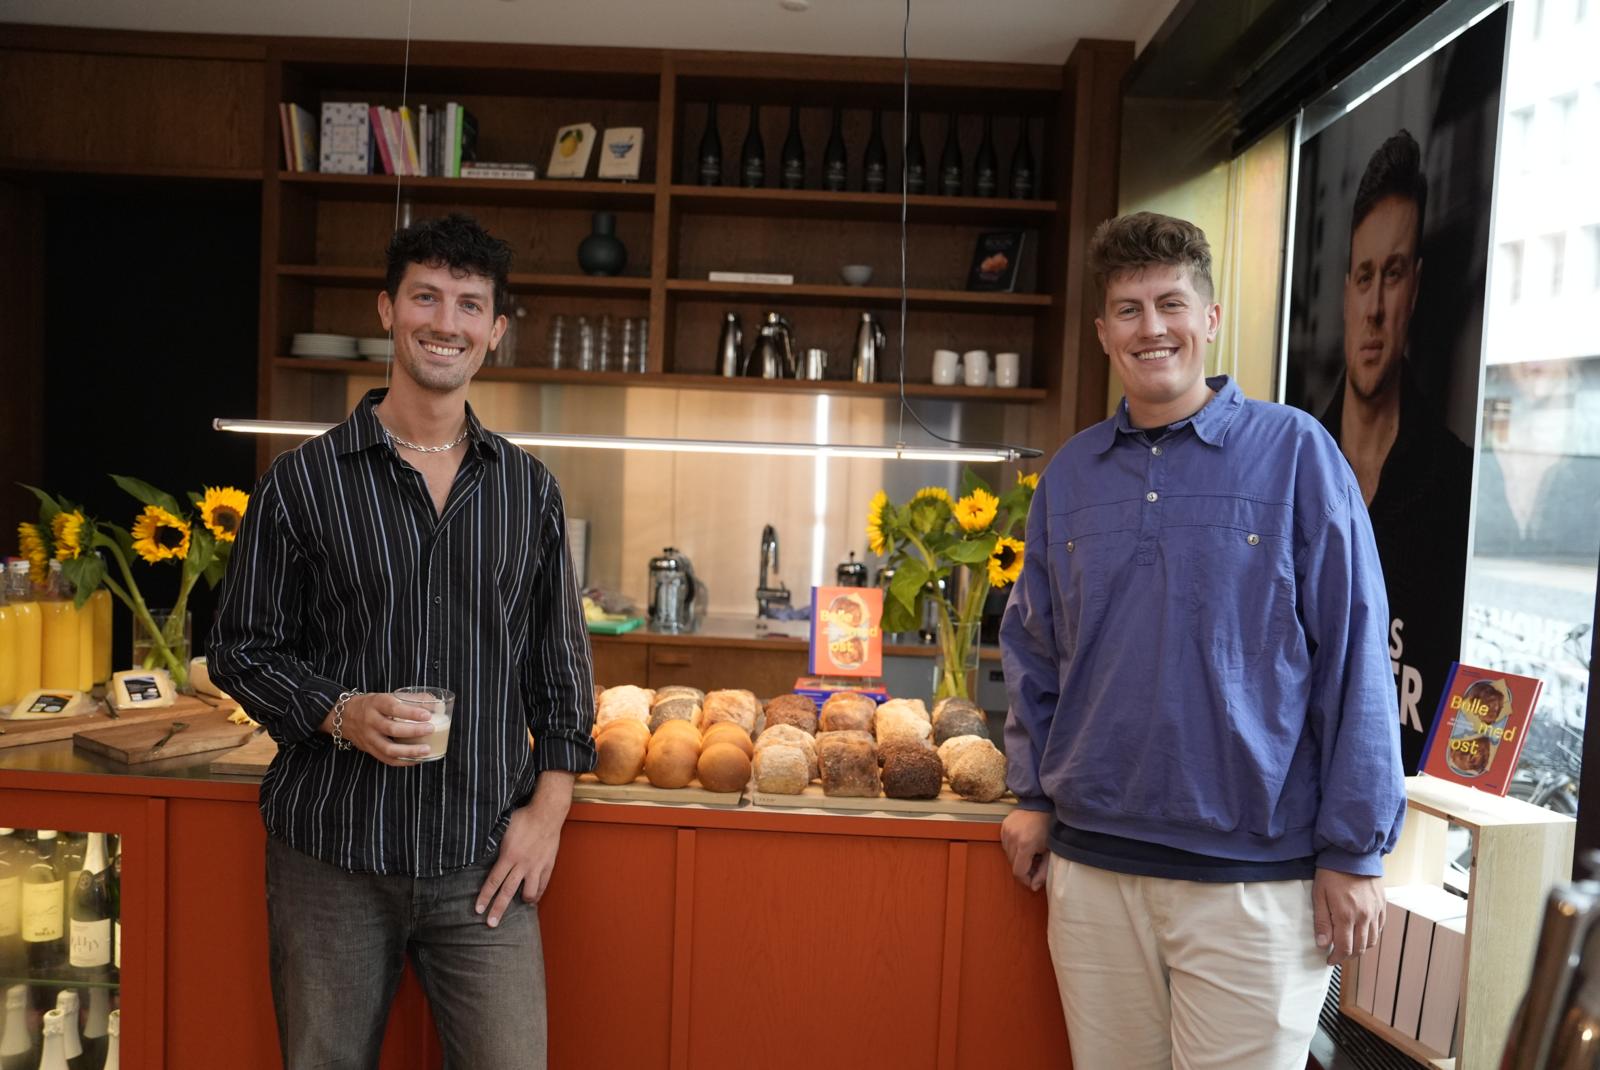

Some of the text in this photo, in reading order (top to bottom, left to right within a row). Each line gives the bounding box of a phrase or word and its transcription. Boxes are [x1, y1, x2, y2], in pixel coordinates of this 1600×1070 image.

[1390, 618, 1404, 660] S
[1450, 695, 1489, 716] Bolle
[1478, 722, 1517, 742] med
[1451, 740, 1479, 755] ost
